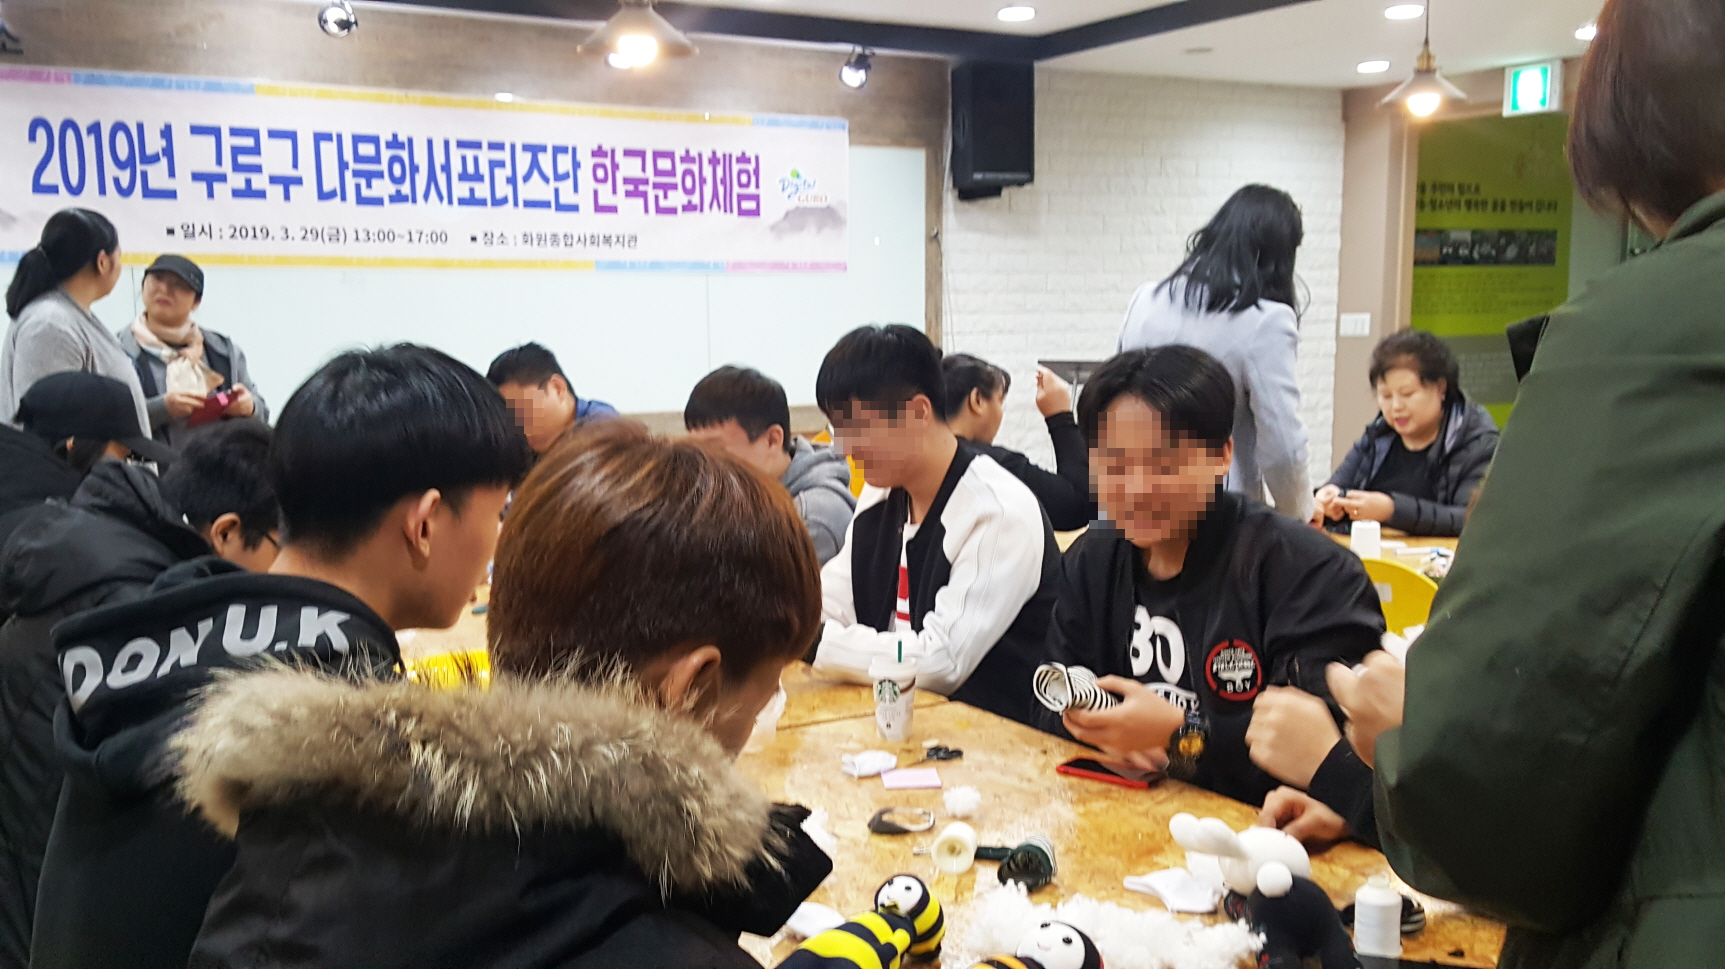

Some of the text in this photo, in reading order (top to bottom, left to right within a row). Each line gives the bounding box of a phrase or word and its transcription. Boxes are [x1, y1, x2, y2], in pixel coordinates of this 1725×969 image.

[28, 116, 761, 217] 2019년 구로구 다문화서포터즈단 한국문화체험
[181, 222, 212, 241] 일시
[229, 224, 275, 241] 2019.
[281, 226, 295, 242] 3.
[300, 226, 347, 245] 29(금)
[353, 228, 448, 244] 13:00~17:00
[482, 232, 509, 247] 장소
